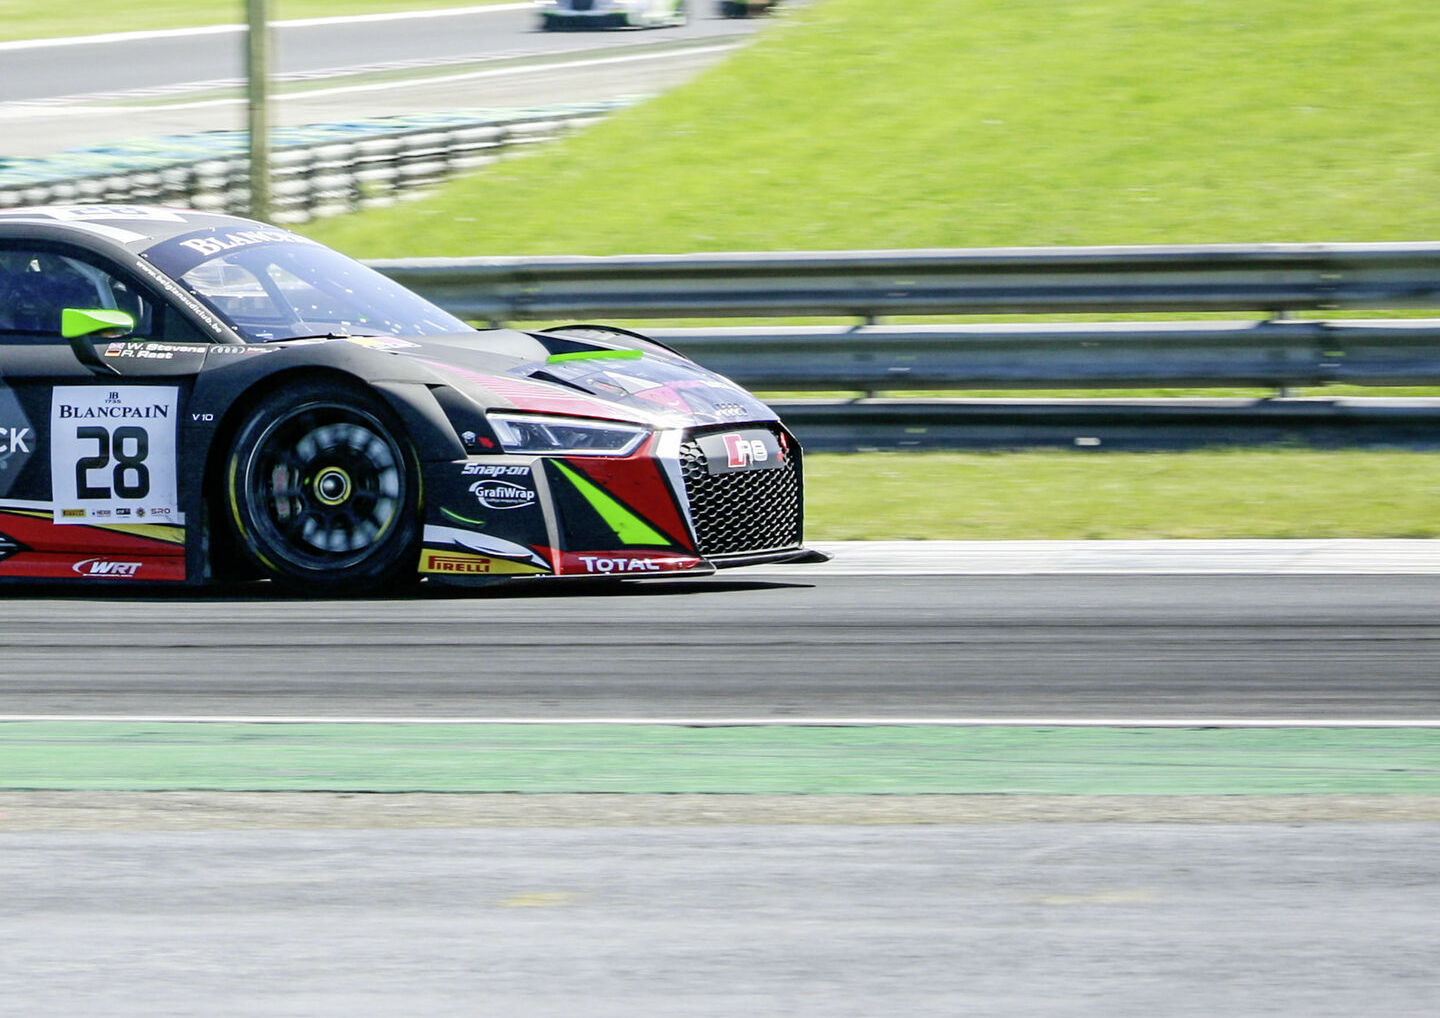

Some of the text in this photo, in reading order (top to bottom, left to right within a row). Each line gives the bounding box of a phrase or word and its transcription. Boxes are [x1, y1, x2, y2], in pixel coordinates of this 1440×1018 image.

[127, 342, 144, 351] W.
[59, 404, 169, 419] BLANCPAIN
[75, 426, 150, 499] 28
[461, 462, 530, 477] Snap-on
[475, 486, 535, 501] GrafiWrap
[90, 561, 142, 575] WRT
[428, 555, 492, 572] PIRELLI
[578, 556, 660, 572] TOTAL
